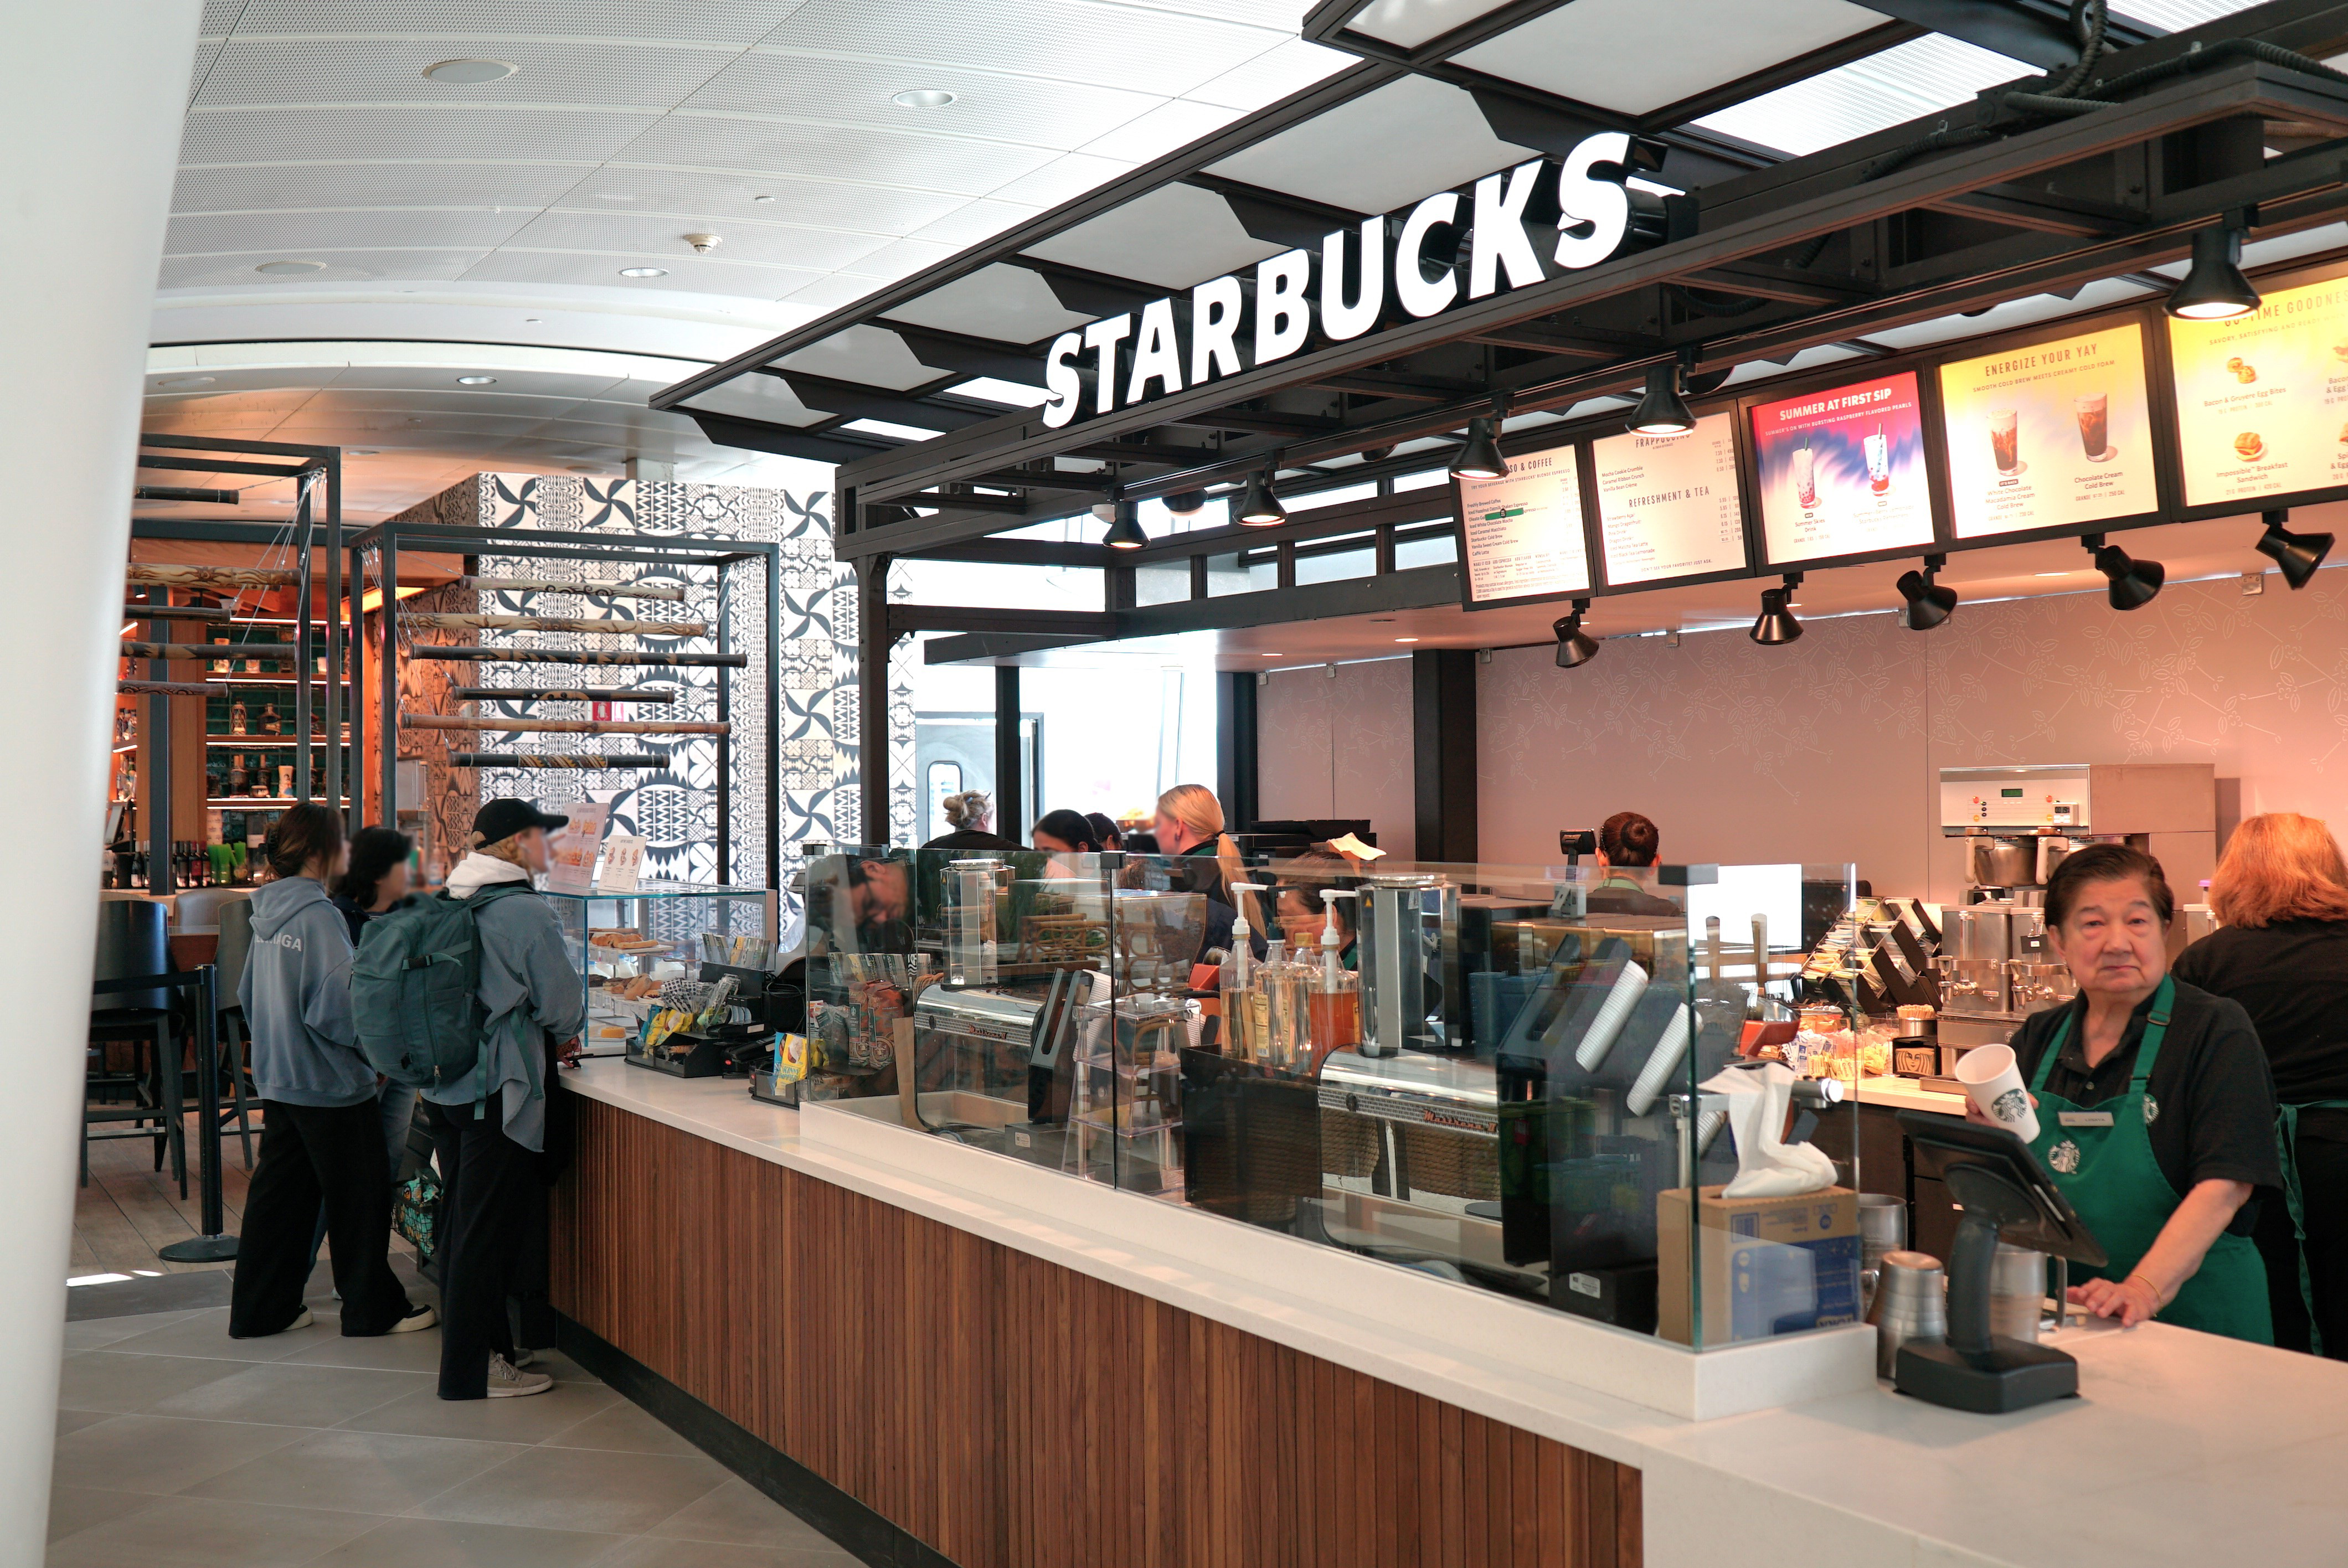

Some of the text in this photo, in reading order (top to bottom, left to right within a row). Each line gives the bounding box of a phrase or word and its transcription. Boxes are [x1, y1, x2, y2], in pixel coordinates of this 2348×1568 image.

[1042, 131, 1631, 429] STARBUCKS
[2209, 335, 2237, 345] SAVORY,
[2239, 326, 2278, 339] SATISFYING
[2298, 317, 2320, 326] READY
[1985, 343, 2097, 376] ENERGIZE YOUR YAY
[1973, 383, 1997, 393] SMOOTH
[2015, 376, 2031, 385] BREW
[2033, 372, 2052, 381] MEETS
[2053, 368, 2078, 377] CREAMY
[2079, 364, 2095, 373] COLD
[2097, 360, 2115, 369] FOAM
[1779, 388, 1892, 421] SUMMER AT FIRST SIP
[1765, 426, 1789, 436] SUMMER'S
[1811, 417, 1836, 427] BURSTING
[1837, 411, 1864, 422] RASPBERRY
[1866, 406, 1891, 416] FLAVORED
[1892, 402, 1912, 410] PEARLS
[1521, 462, 1525, 471] &
[1528, 458, 1552, 470] COFFEE
[2237, 473, 2268, 483] Sandwich
[2257, 462, 2288, 471] Breakfast
[1629, 486, 1709, 508] REFRESHMENT & TEA
[1423, 1109, 1485, 1130] Mastrena
